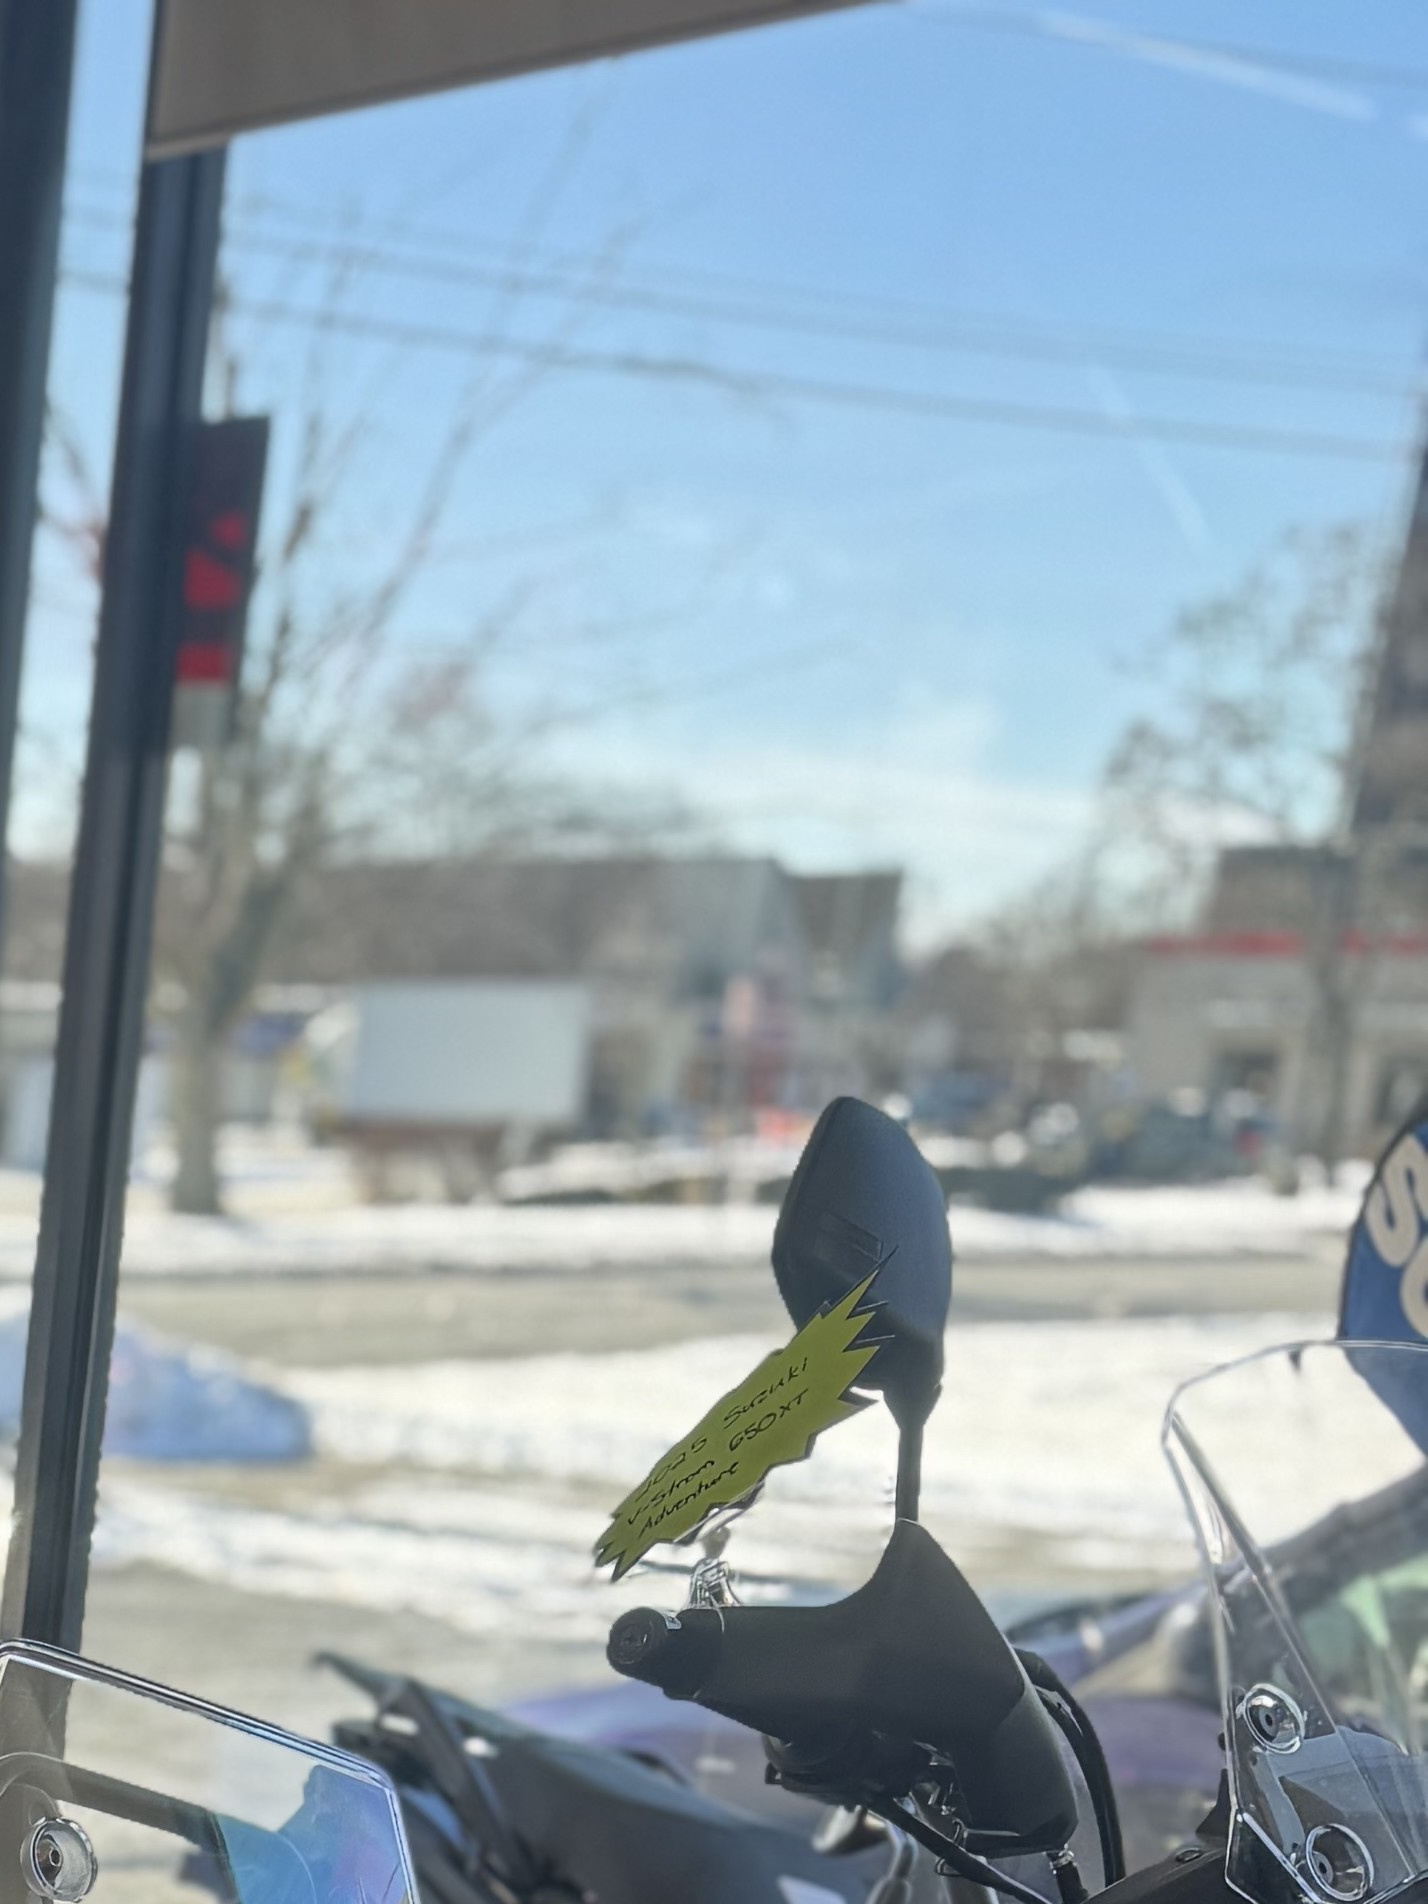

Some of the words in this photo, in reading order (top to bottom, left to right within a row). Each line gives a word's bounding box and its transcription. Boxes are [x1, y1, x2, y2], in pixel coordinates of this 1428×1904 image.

[723, 1356, 809, 1430] Suzuki
[728, 1387, 809, 1452] 650XT
[637, 1461, 740, 1540] Adventure
